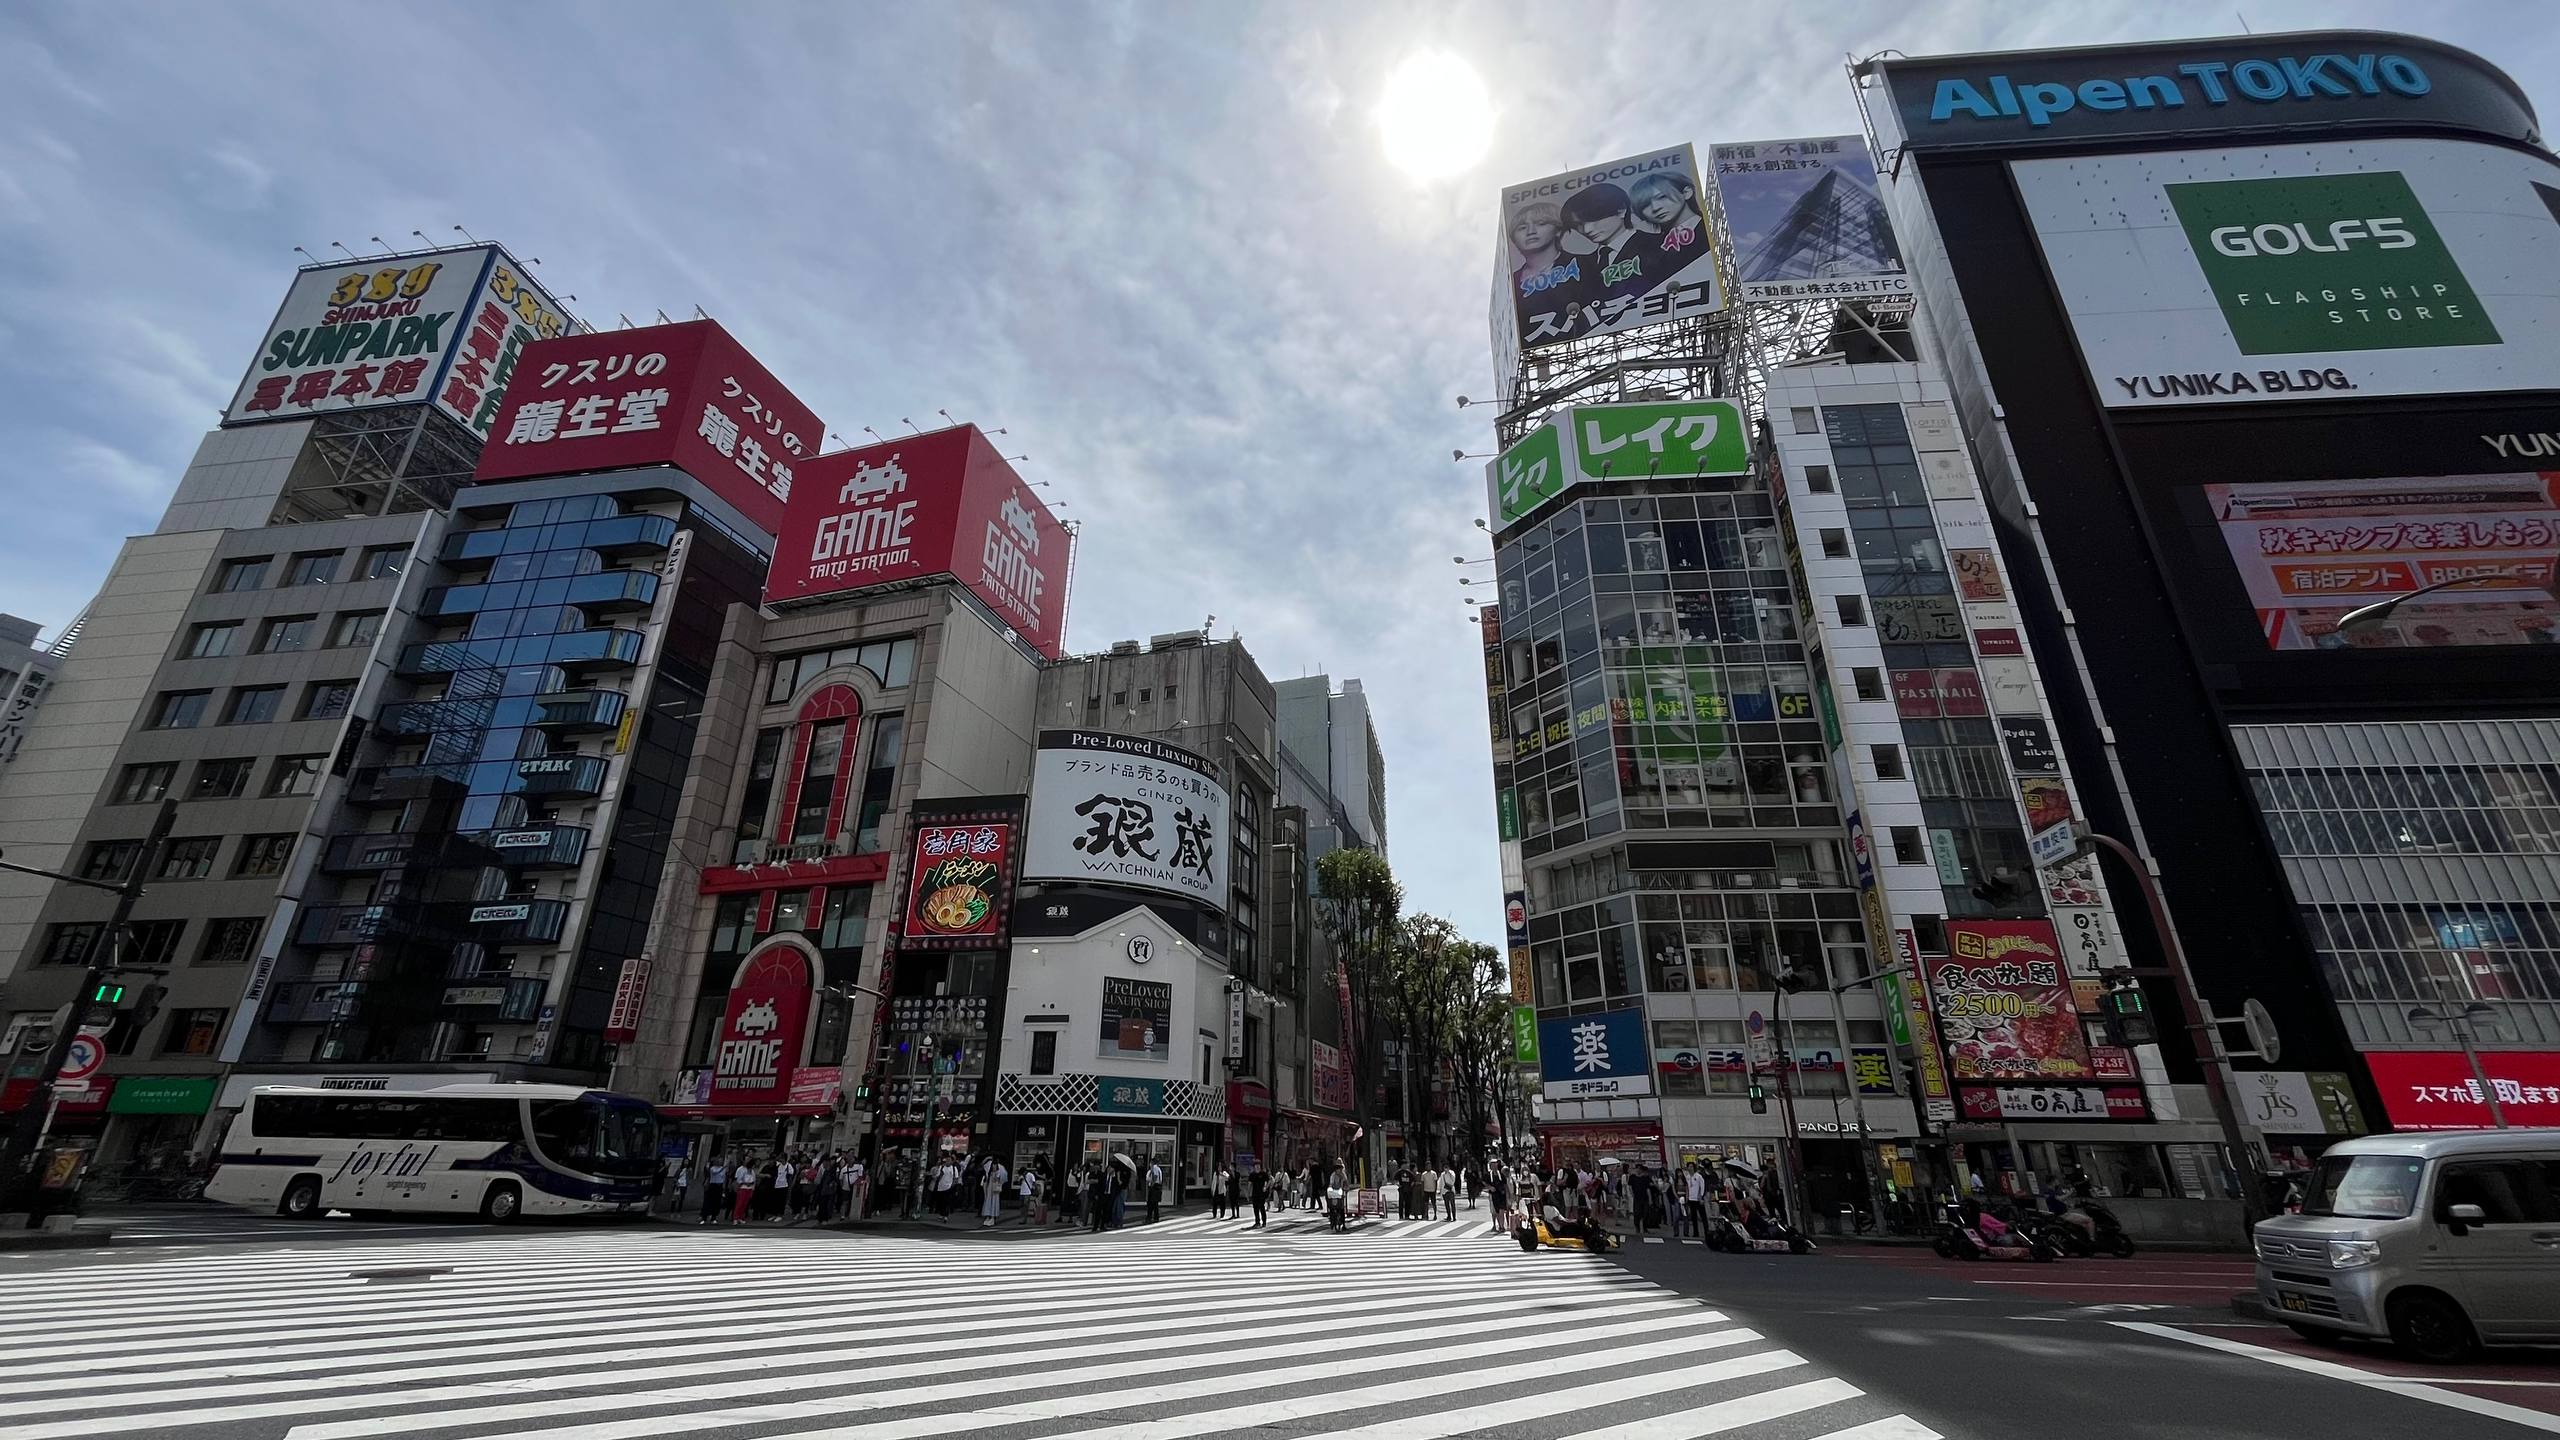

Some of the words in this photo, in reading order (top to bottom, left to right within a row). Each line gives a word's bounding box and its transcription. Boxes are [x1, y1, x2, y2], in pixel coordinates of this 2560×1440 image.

[1931, 75, 2185, 127] Alpen
[2179, 53, 2431, 104] TOKYO
[1510, 182, 1561, 205] SPICE
[1564, 153, 1682, 190] CHOCOLATE
[1660, 226, 1696, 253] AO
[2210, 217, 2416, 257] GOLF5
[327, 263, 443, 308] 389
[1520, 257, 1581, 297] SORA
[1600, 257, 1642, 288] REI
[1748, 278, 1909, 298] 不動産は株式会社TFC
[1524, 279, 1711, 343] スパチョコ
[2239, 284, 2448, 306] FLAGSHIP
[322, 299, 421, 326] SHINJUKU
[2328, 304, 2464, 324] STORE
[263, 311, 455, 371] SUNPARK
[245, 358, 429, 412] 三平本館
[541, 352, 667, 389] クスリの
[2116, 371, 2258, 399] YUNIKA
[2260, 368, 2357, 394] BLDG.
[505, 388, 669, 446] 龍生堂
[722, 376, 802, 456] クスリの
[1585, 415, 1718, 455] レイク
[698, 403, 793, 504] 龍生堂
[1502, 456, 1549, 505] レイク
[811, 501, 917, 561] GAME
[809, 559, 847, 579] TAITO
[851, 549, 909, 572] STATION
[983, 520, 1044, 615] GAME
[2290, 568, 2403, 590] 宿泊テント
[981, 567, 1006, 603] TAITO
[1006, 591, 1040, 633] STATION
[1895, 673, 1909, 682] 6F
[1899, 687, 1977, 699] FASTNAIL
[1577, 705, 1606, 729] 夜間
[1656, 700, 1685, 717] 内科
[1780, 696, 1810, 716] 6F
[1547, 720, 1573, 744] 祝日
[2004, 730, 2036, 739] Rydia
[2025, 739, 2034, 747] &
[1072, 733, 1152, 754] Pre-Loved
[1157, 745, 1200, 771] Luxury
[1137, 788, 1183, 804] GINZO
[1073, 793, 1214, 883] 銀蔵
[943, 861, 990, 877] ラーメン
[1181, 876, 1209, 892] GROUP
[1509, 908, 1524, 927] 薬
[1104, 978, 1170, 999] PreLoved
[1938, 961, 2059, 991] 食べ放題
[1104, 993, 1142, 1007] LUXURY
[1885, 979, 1904, 1031] レイク
[1518, 1014, 1532, 1050] レイク
[1570, 1022, 1611, 1073] 薬
[716, 1039, 784, 1075] GAME
[1852, 1054, 1890, 1089] 薬
[740, 1076, 777, 1089] STATION
[327, 1142, 439, 1185] joyful
